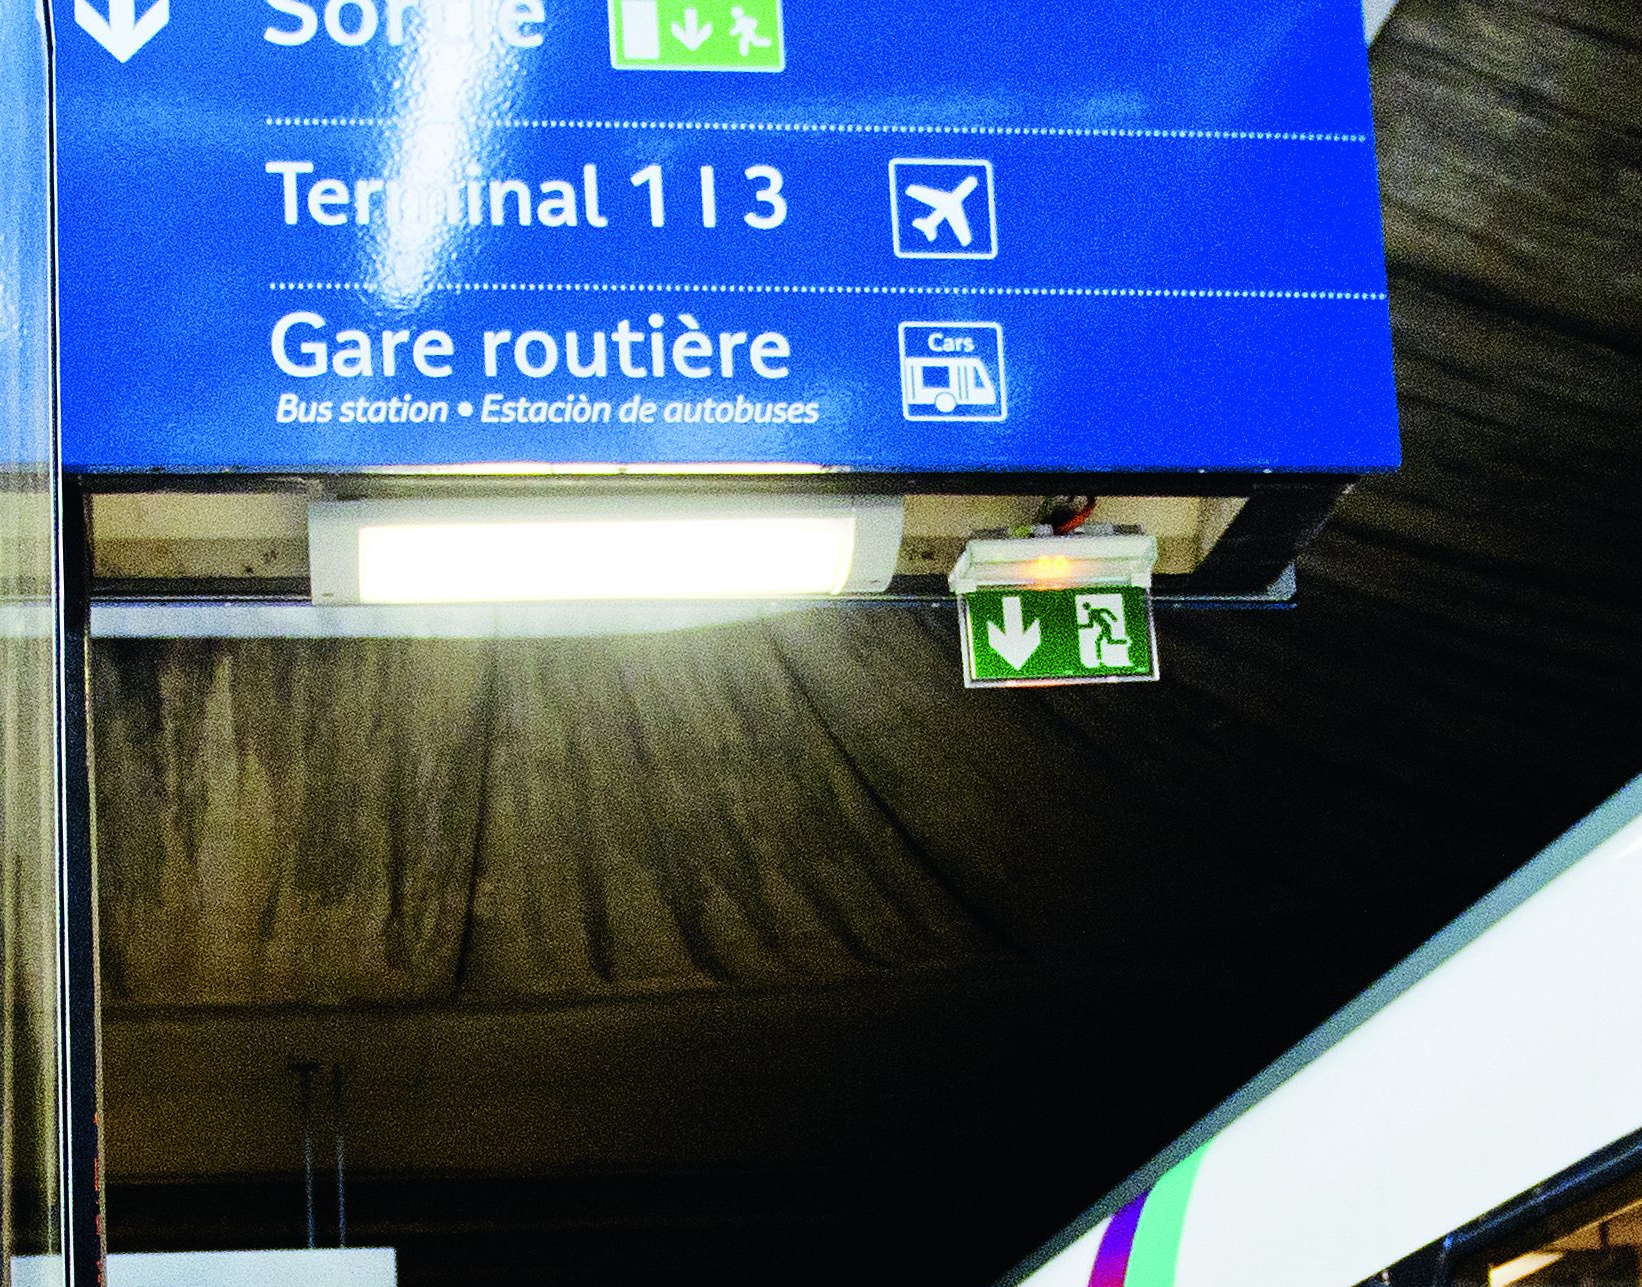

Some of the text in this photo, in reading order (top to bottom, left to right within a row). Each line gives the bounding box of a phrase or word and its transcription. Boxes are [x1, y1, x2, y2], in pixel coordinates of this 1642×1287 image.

[265, 161, 608, 227] Terminal
[631, 164, 665, 228] 1
[744, 165, 787, 230] 3
[271, 311, 790, 378] Gare routière
[928, 332, 975, 352] Cars
[276, 392, 333, 423] Bus
[339, 393, 448, 423] station
[618, 394, 657, 423] de
[662, 394, 820, 424] autobuses
